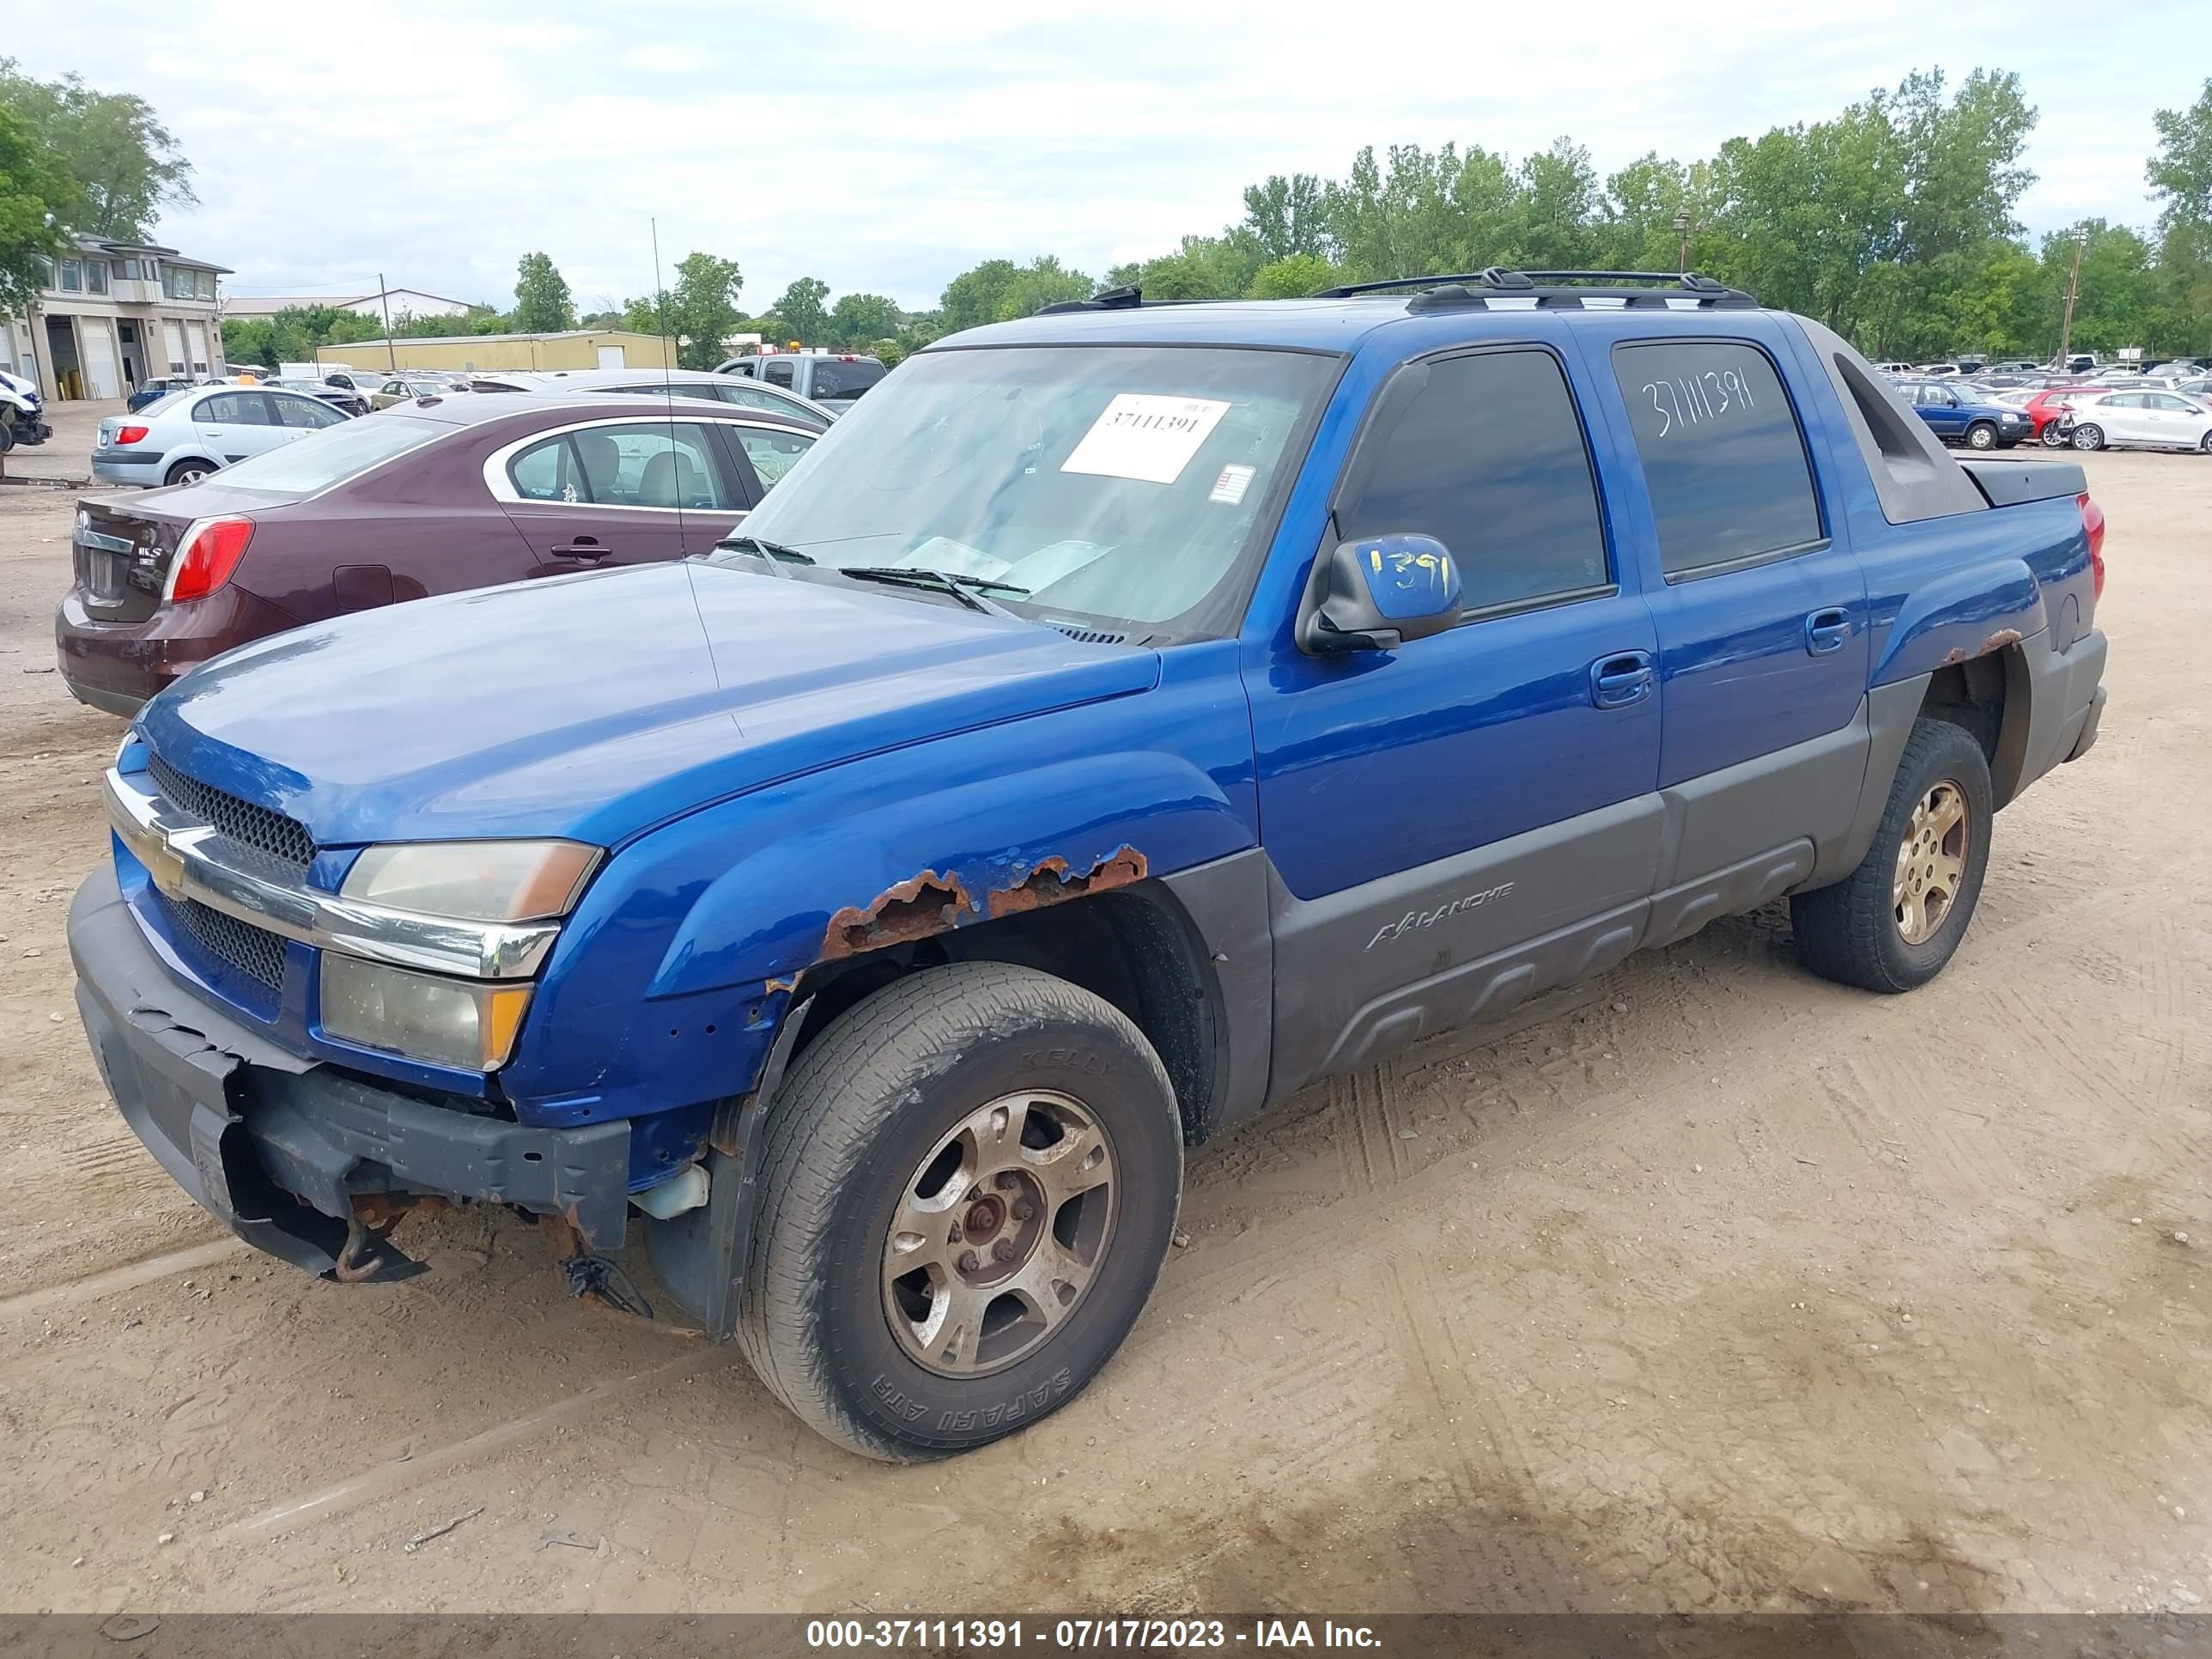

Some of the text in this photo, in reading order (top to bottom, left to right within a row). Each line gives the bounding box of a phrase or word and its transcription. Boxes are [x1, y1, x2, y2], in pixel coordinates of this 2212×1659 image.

[1106, 412, 1200, 433] 37111391
[1642, 366, 1754, 438] 37111391
[1369, 550, 1450, 599] 1391
[1364, 881, 1516, 952] AVALANCHE
[1017, 1048, 1120, 1079] KELLY
[870, 1367, 1073, 1432] SAFARI ATR
